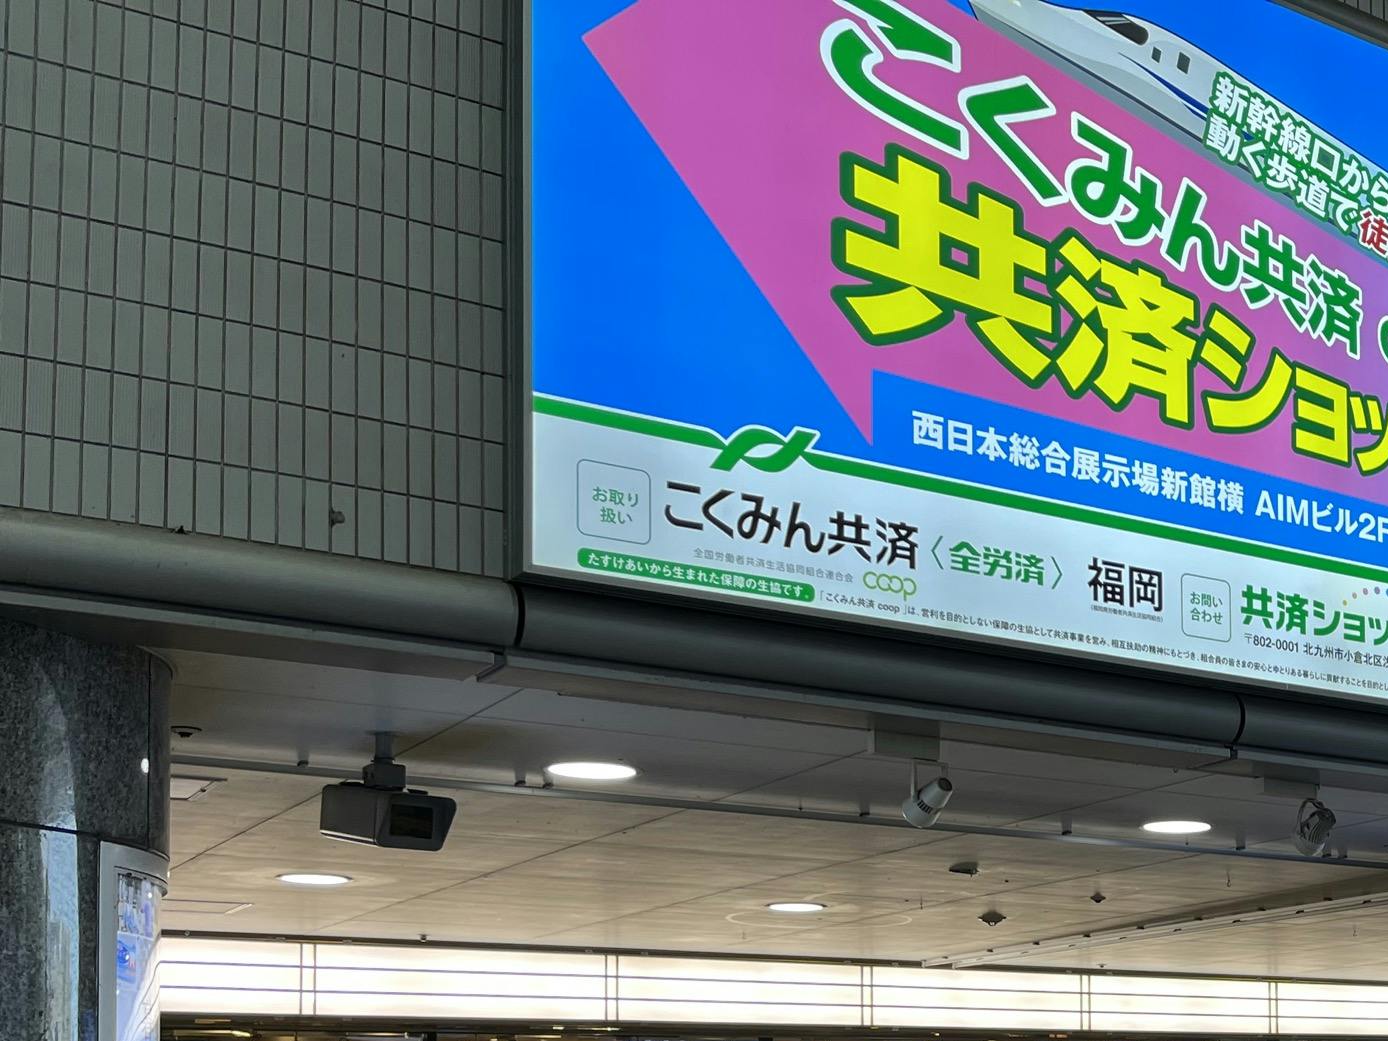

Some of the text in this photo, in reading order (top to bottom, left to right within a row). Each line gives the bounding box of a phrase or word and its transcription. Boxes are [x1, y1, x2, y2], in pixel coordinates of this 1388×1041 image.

[819, 0, 1362, 360] こくみん共済
[910, 410, 1245, 514] 西日本総合展示場新館横
[591, 485, 640, 508] お取り
[599, 506, 634, 525] 扱い
[663, 480, 919, 570] こくみん共済
[1087, 556, 1164, 613] 福岡
[587, 552, 810, 601] たすけあいから生まれた保障の生協です。
[862, 570, 918, 601] coop
[1189, 591, 1224, 608] お問い
[1189, 607, 1224, 625] 合わせ
